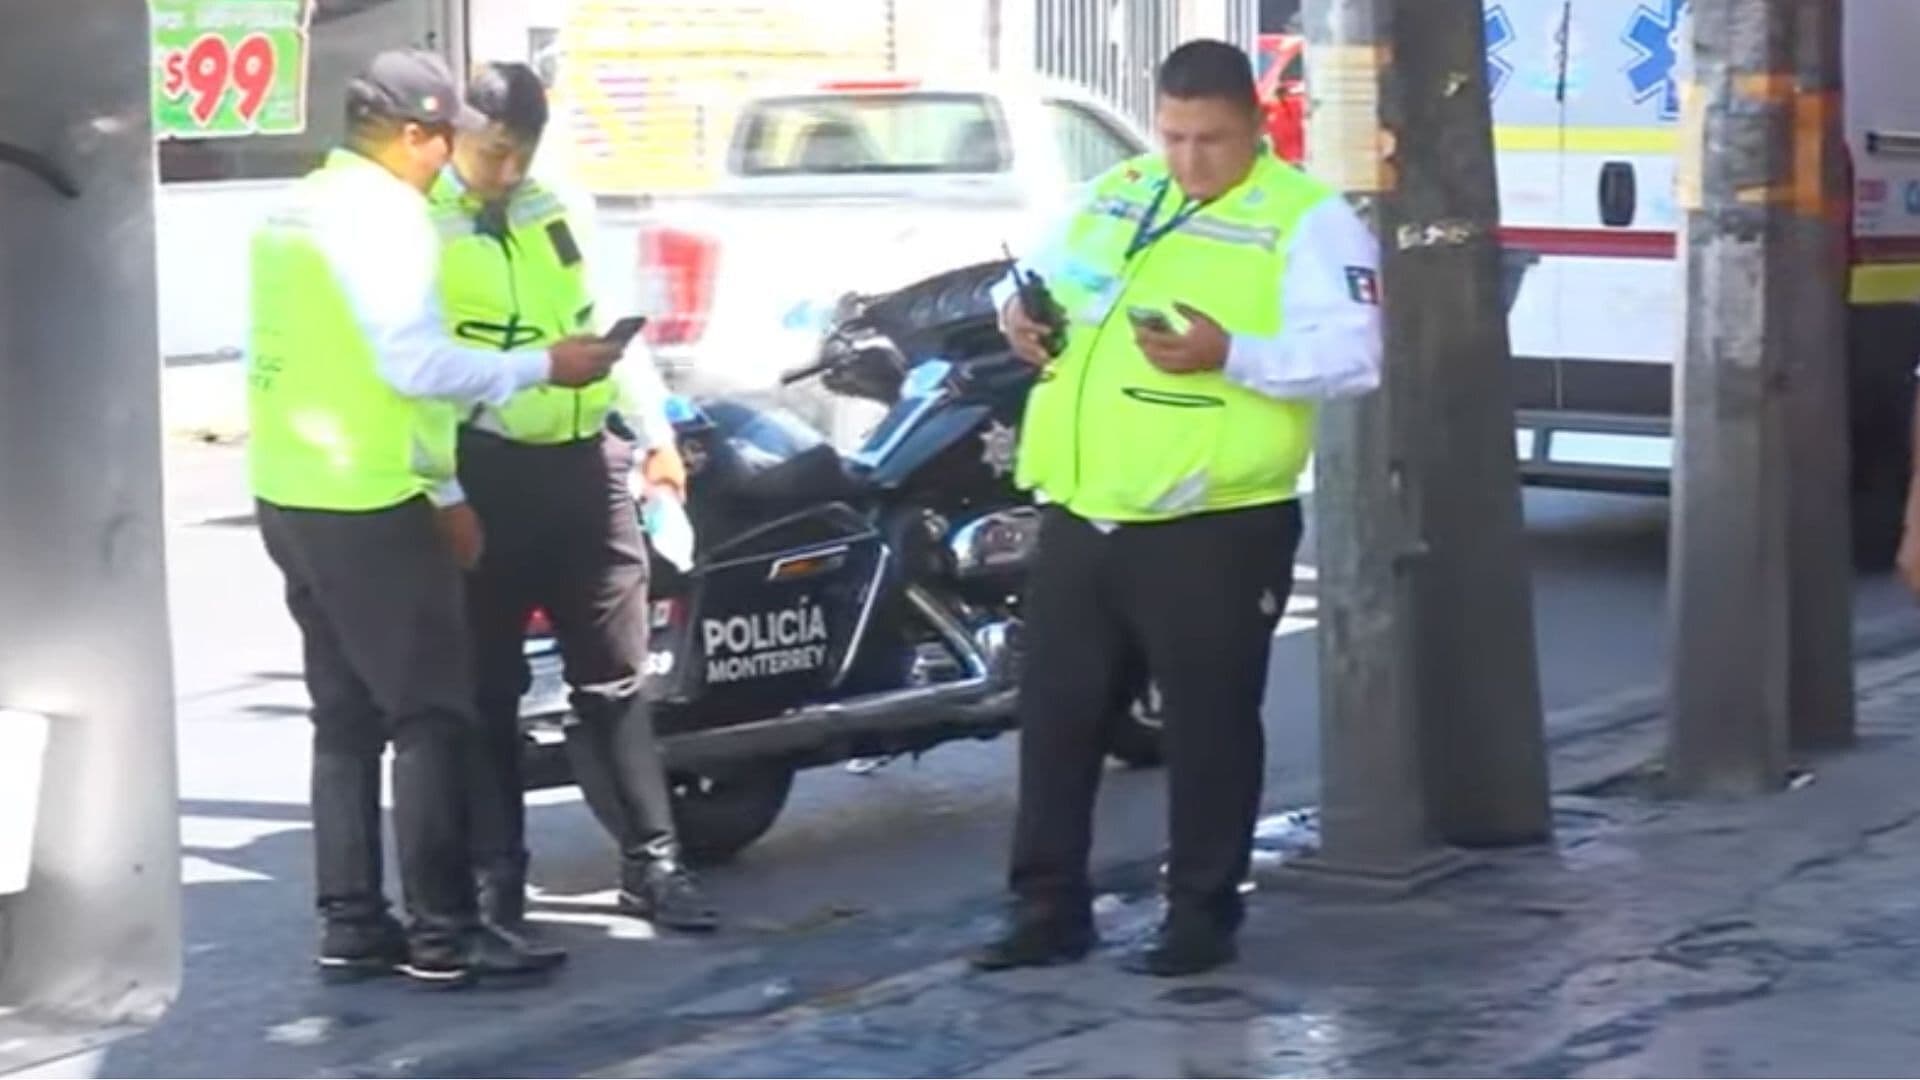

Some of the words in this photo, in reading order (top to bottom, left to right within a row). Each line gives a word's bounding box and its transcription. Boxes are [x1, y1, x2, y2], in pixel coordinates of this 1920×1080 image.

[165, 35, 274, 123] $99
[703, 595, 827, 656] POLICÍA
[706, 644, 827, 682] MONTERREY
